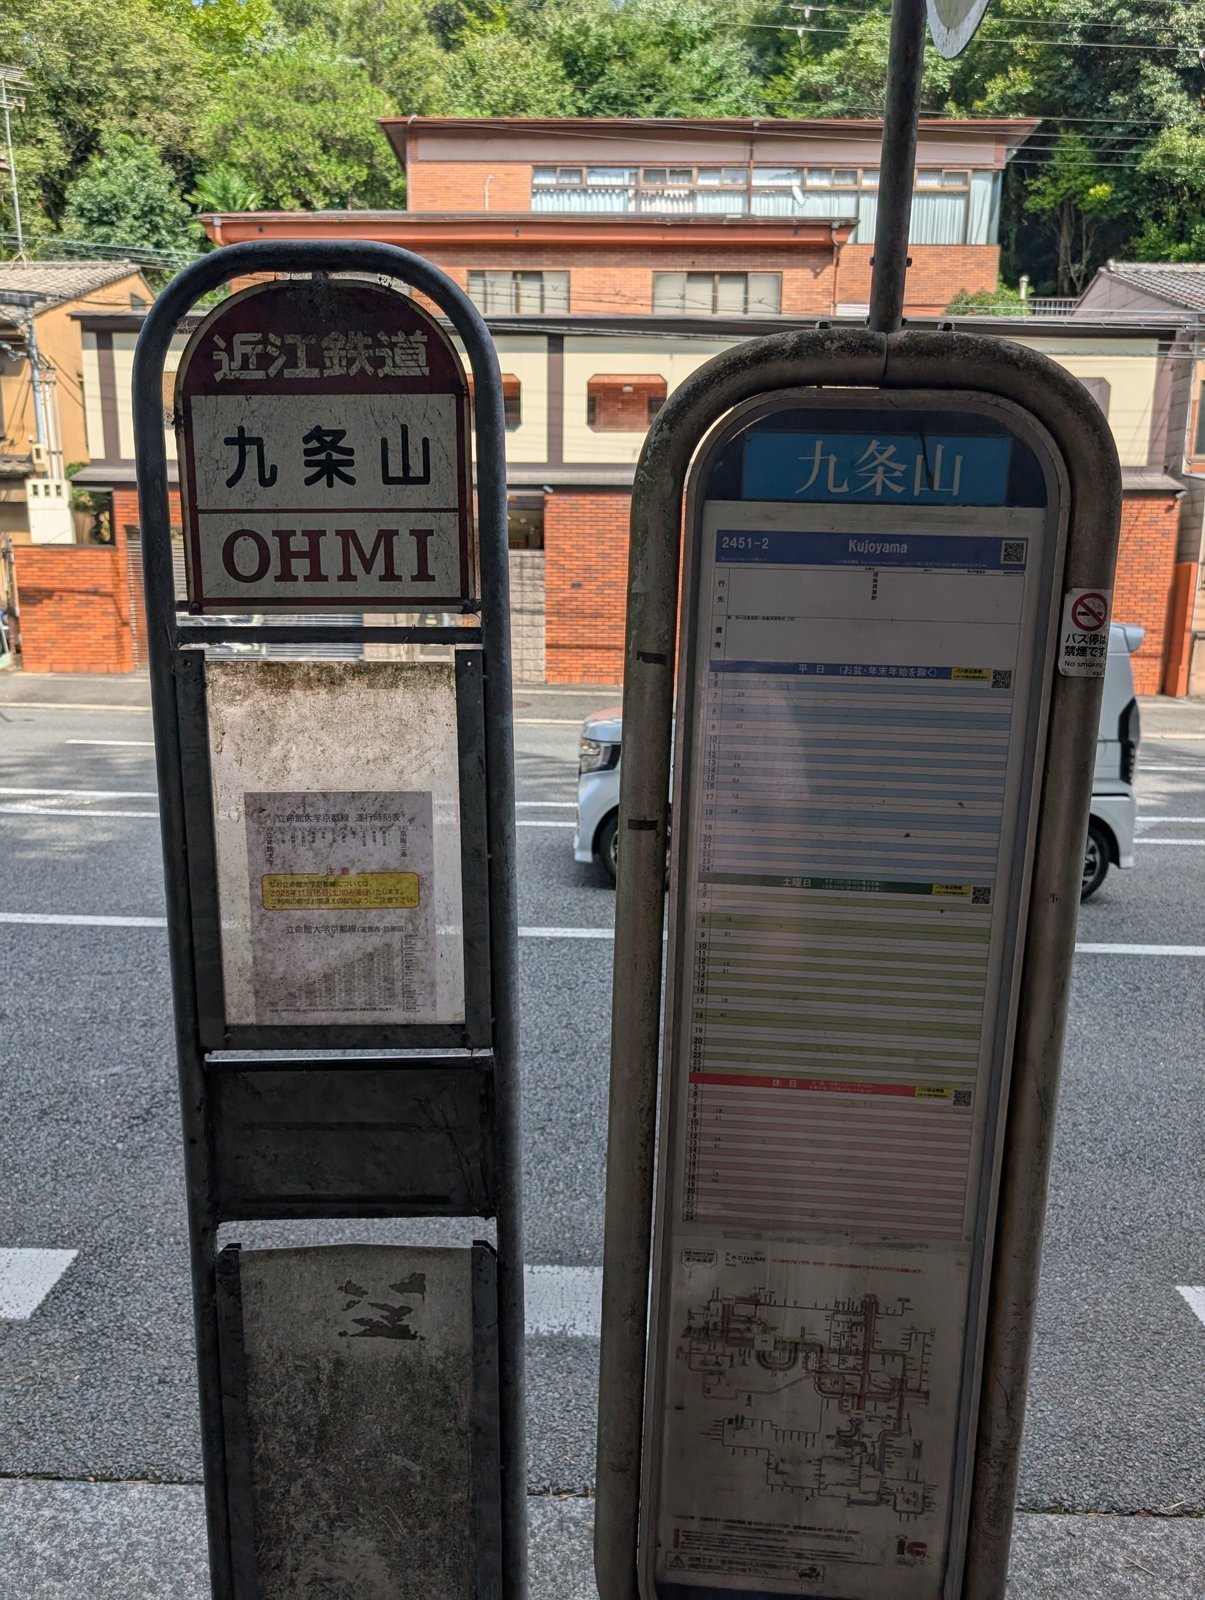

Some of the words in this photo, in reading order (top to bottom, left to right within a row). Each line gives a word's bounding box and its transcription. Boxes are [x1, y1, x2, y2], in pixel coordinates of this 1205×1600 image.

[212, 329, 430, 383] 近江鉄道
[223, 423, 432, 489] 九条山
[795, 439, 963, 497] 九条山
[721, 536, 770, 550] 2451-2
[848, 539, 909, 554] Kujoyama
[221, 528, 437, 584] OHMI
[1065, 633, 1107, 645] バス停は
[1064, 645, 1106, 657] 禁煙です
[798, 665, 825, 674] 平日
[782, 877, 812, 888] 土曜日
[772, 1079, 797, 1088] 休日
